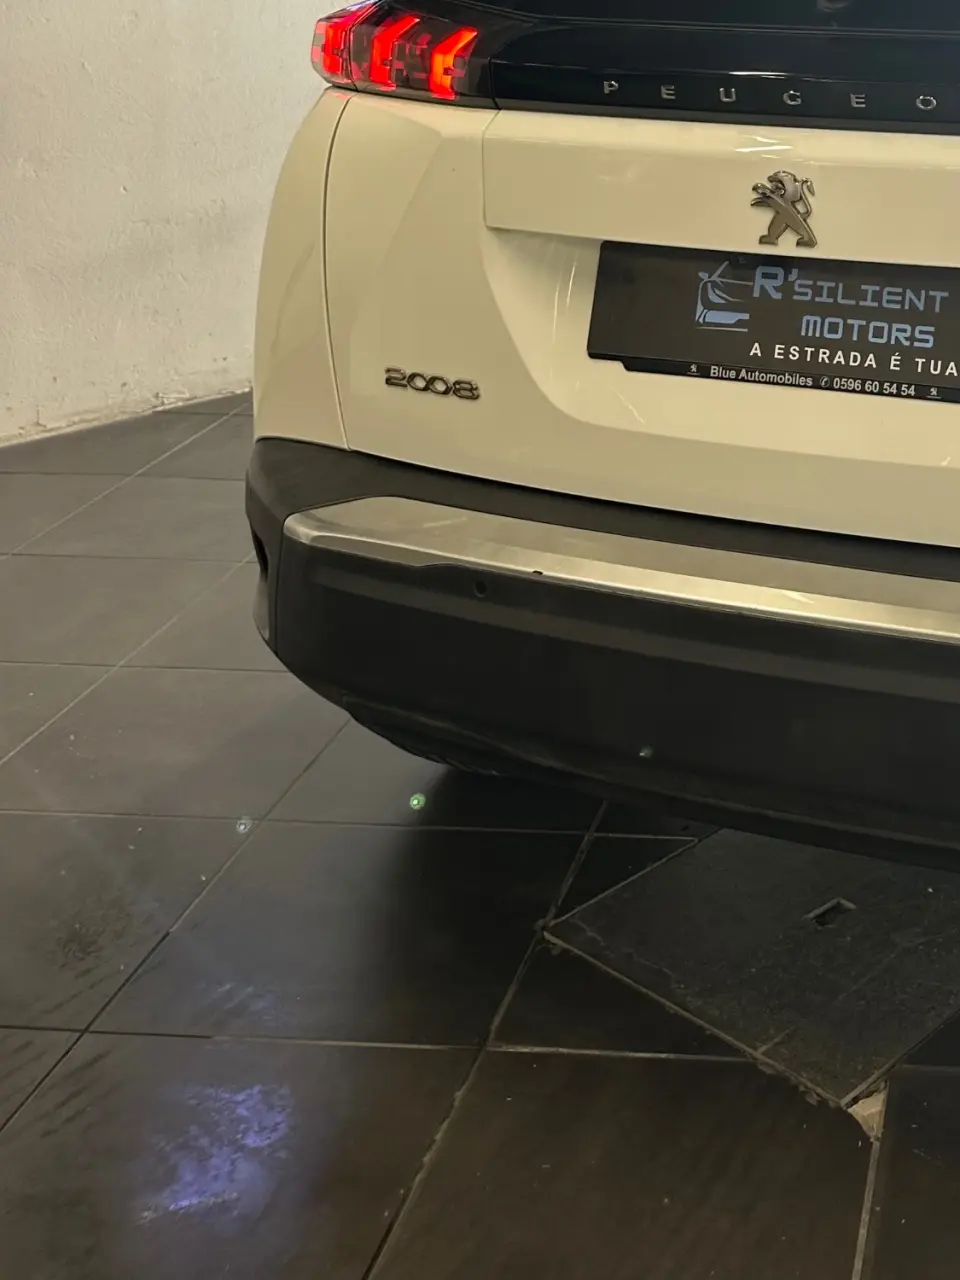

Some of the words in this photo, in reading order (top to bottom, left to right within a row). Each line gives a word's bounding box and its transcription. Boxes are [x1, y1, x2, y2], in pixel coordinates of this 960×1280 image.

[752, 265, 950, 313] R'SILIENT
[800, 315, 936, 349] MOTORS
[749, 342, 763, 357] A
[773, 344, 877, 369] ESTRADA
[889, 353, 902, 371] É
[914, 358, 959, 377] TUA
[384, 366, 480, 400] 2008
[709, 365, 737, 380] Blue
[738, 368, 814, 388] Automobiles
[832, 378, 862, 391] 0596
[864, 381, 880, 393] 60
[882, 383, 899, 395] 54
[900, 384, 916, 397] 54
